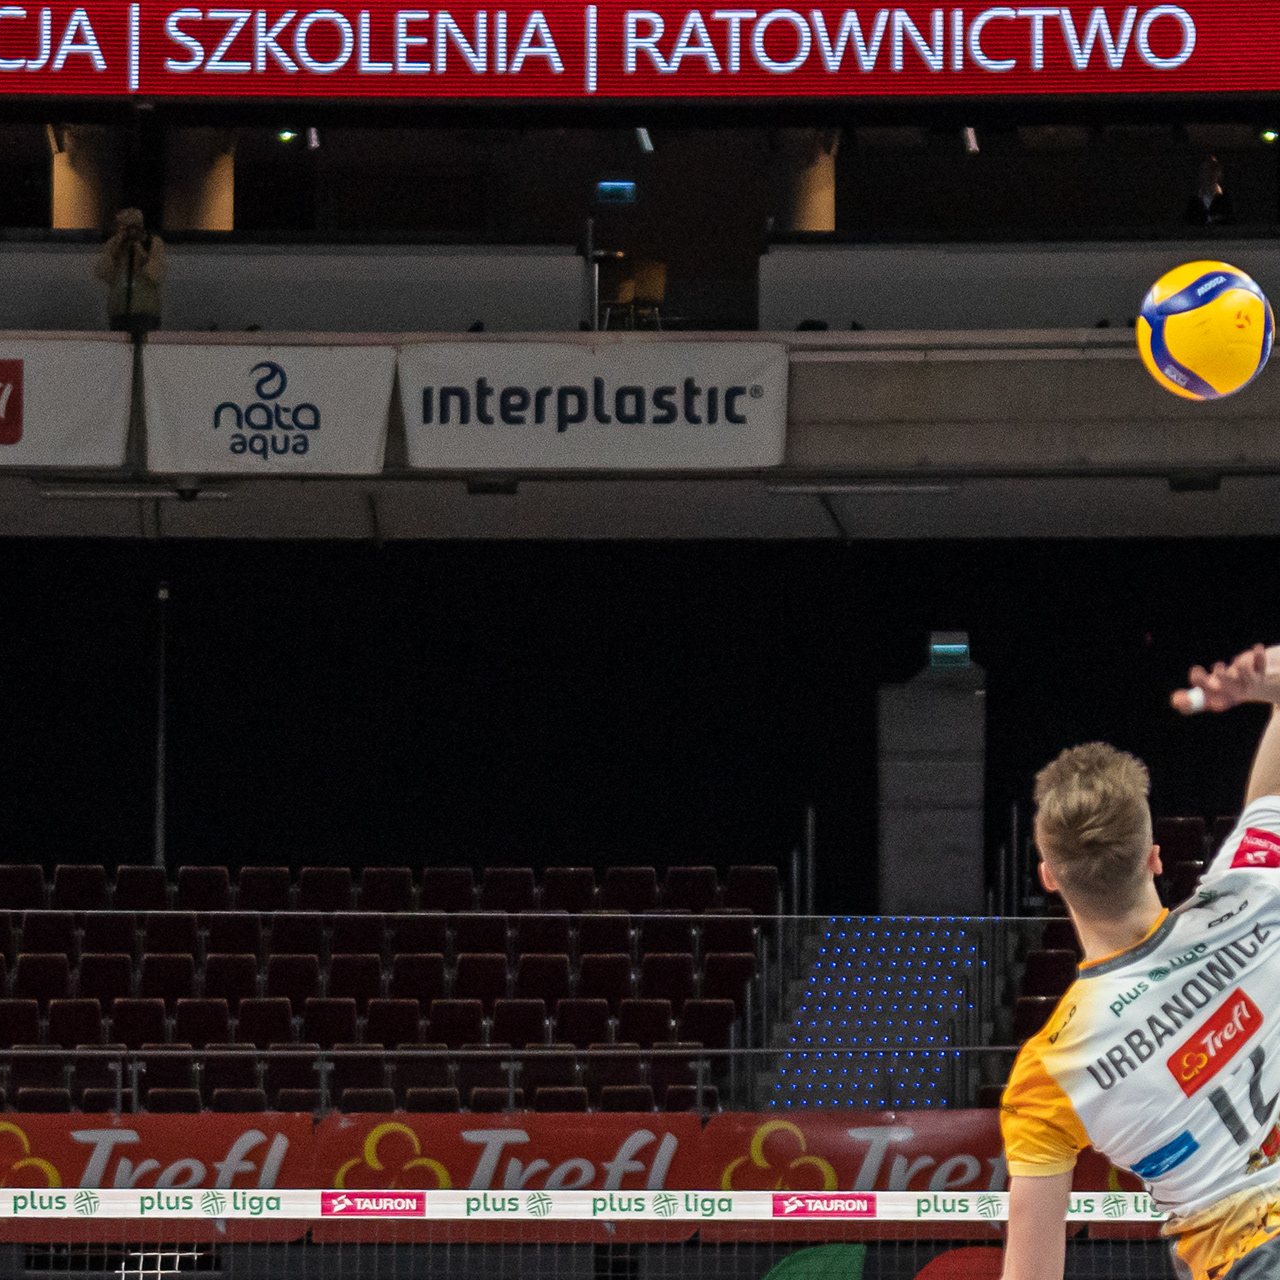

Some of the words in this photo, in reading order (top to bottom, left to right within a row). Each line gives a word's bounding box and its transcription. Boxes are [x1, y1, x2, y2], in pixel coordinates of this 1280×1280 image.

[164, 7, 566, 74] SZKOLENIA
[623, 4, 1198, 74] RATOWNICTWO
[213, 400, 320, 431] nata
[230, 433, 310, 460] aqua
[1086, 923, 1271, 1091] URBANOWICZ
[1109, 980, 1150, 1017] plus
[1202, 1000, 1251, 1057] Trefl
[1208, 1046, 1280, 1147] 12
[848, 1127, 1007, 1191] Tre
[70, 1129, 290, 1231] Trefl
[460, 1129, 678, 1231] Trefl
[12, 1191, 67, 1215] plus
[139, 1191, 193, 1215] plus
[233, 1190, 281, 1215] liga
[355, 1198, 417, 1210] TAURON
[466, 1193, 520, 1216] plus
[592, 1194, 645, 1217] plus
[685, 1193, 733, 1218] liga
[805, 1199, 869, 1212] TAURON
[916, 1194, 969, 1218] plus
[1133, 1194, 1163, 1219] lig
